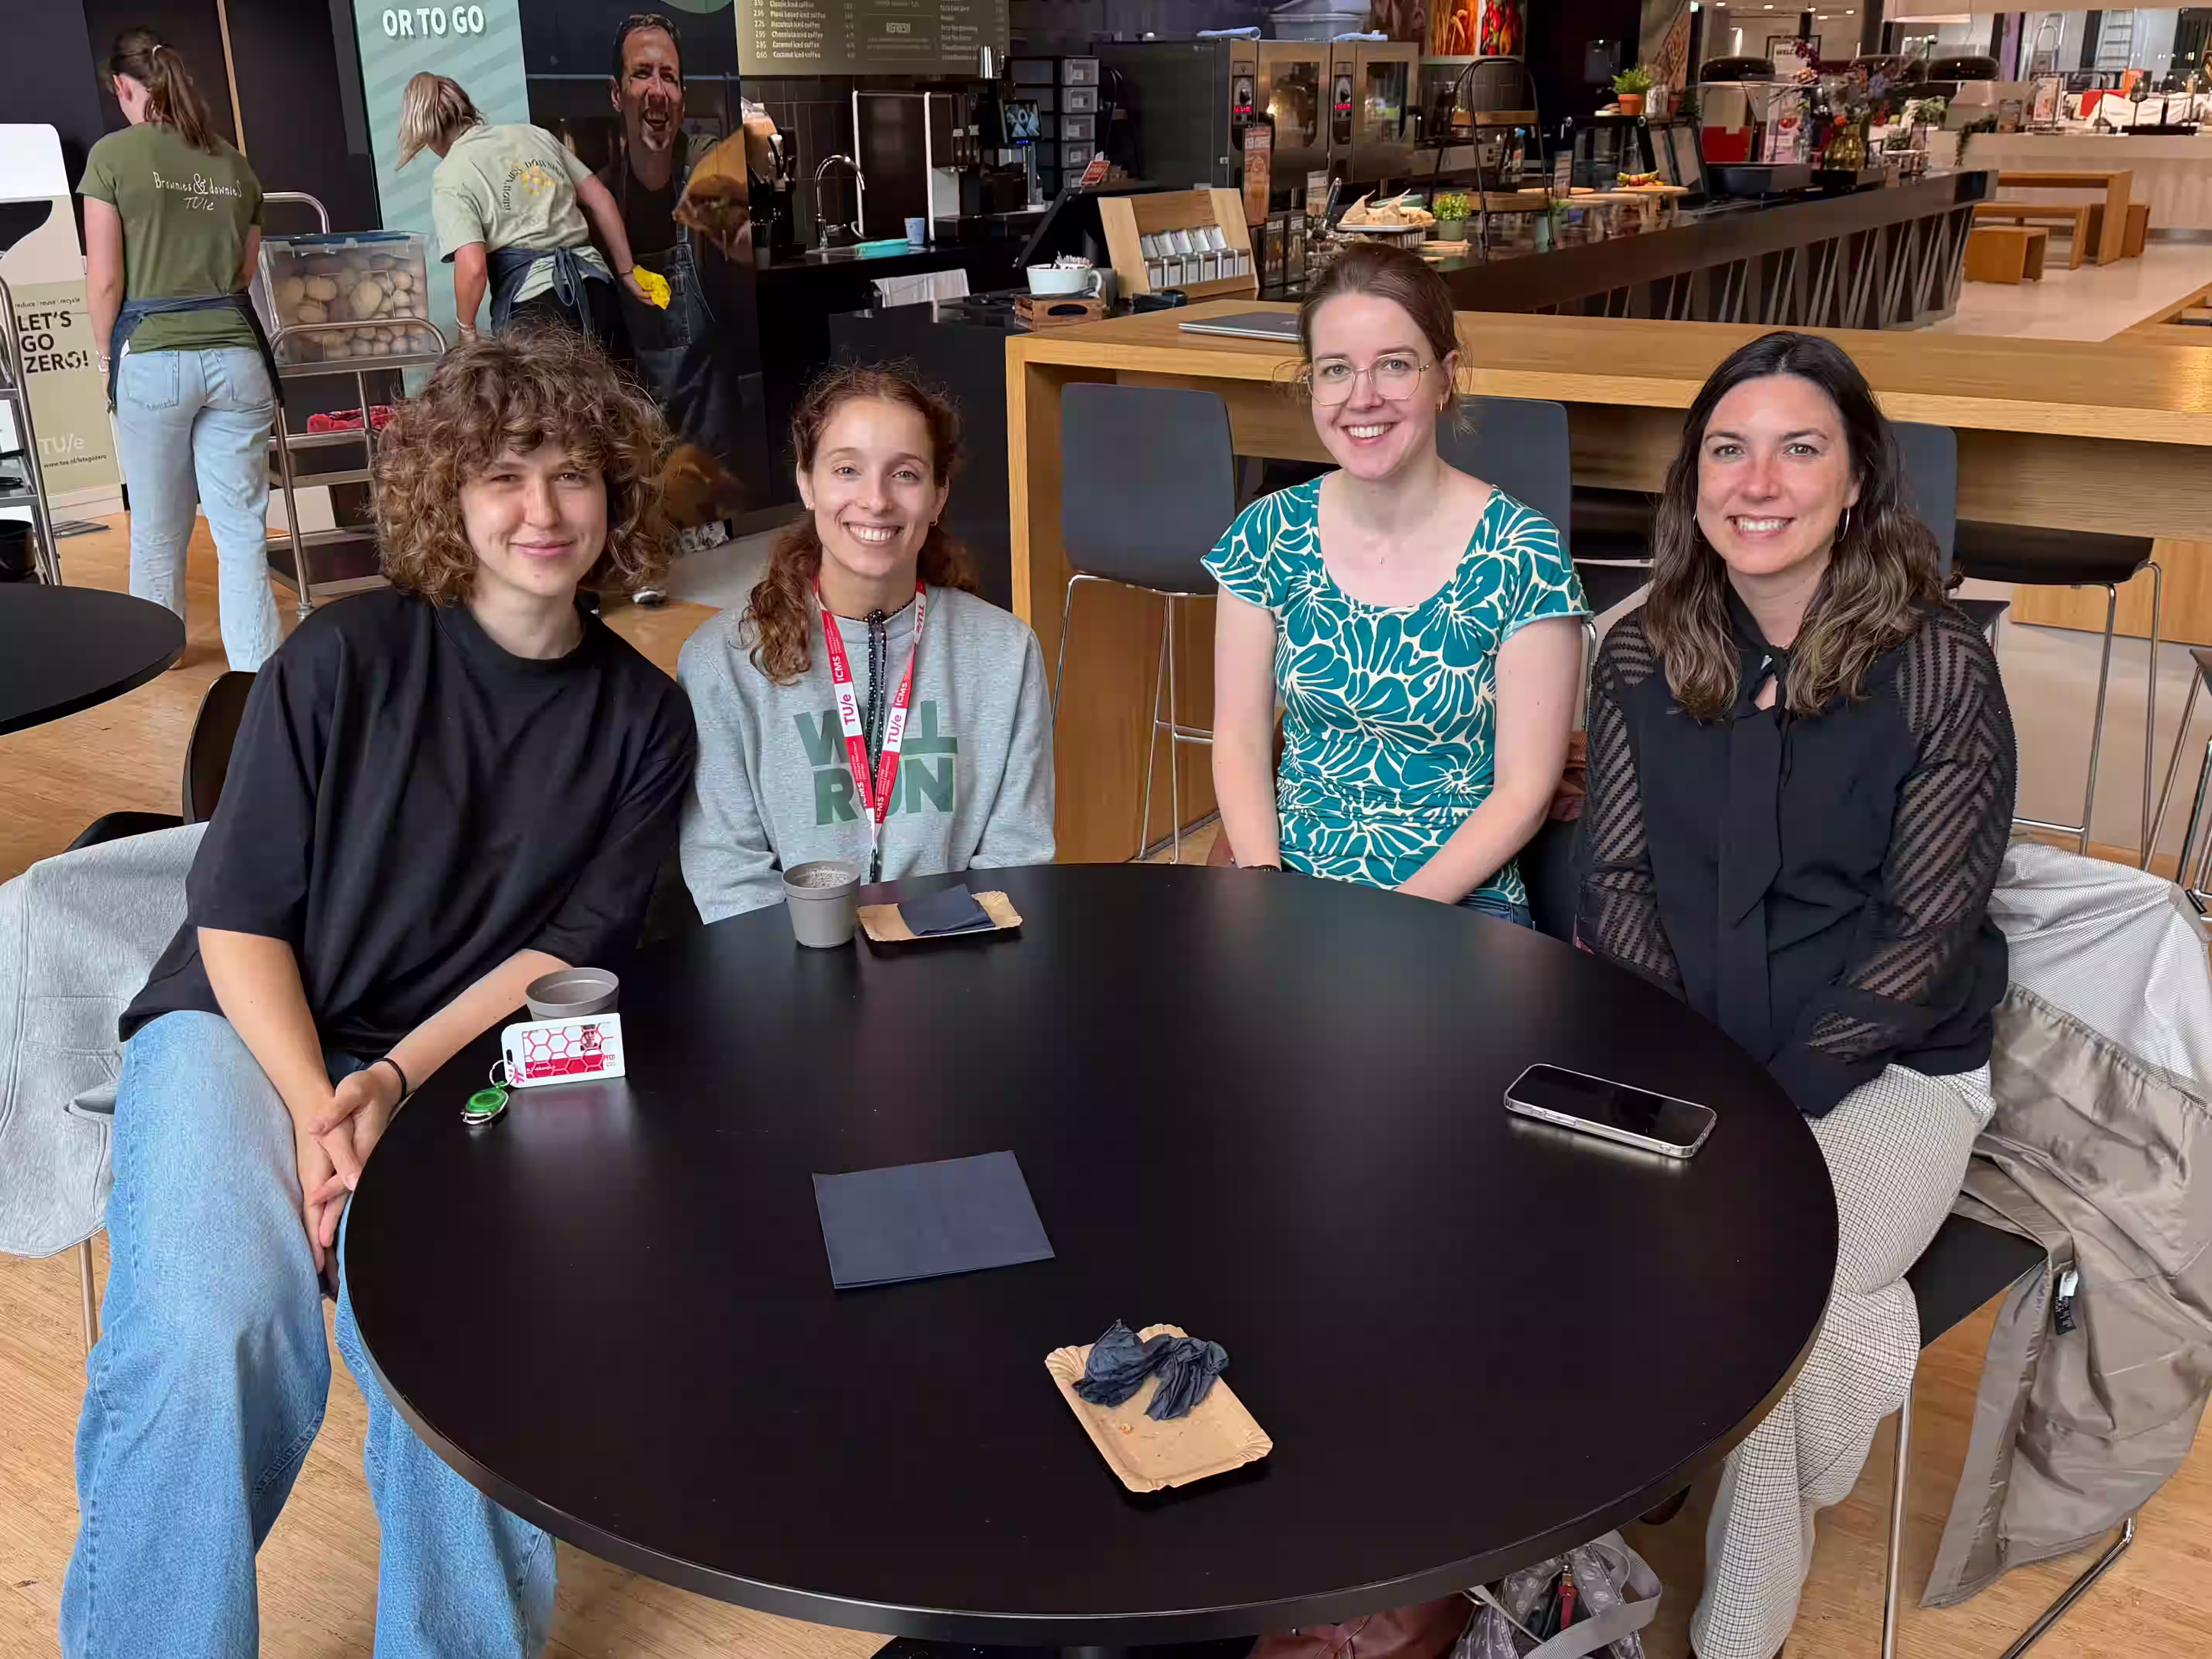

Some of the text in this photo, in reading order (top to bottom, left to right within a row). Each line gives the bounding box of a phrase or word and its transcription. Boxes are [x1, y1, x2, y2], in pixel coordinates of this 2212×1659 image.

[383, 5, 484, 36] OR TO GO
[153, 171, 192, 191] Brownies
[17, 311, 72, 332] LET'S
[21, 333, 55, 353] GO
[23, 350, 89, 374] ZERO!
[38, 433, 85, 455] TU/e
[833, 656, 845, 682] ICMS
[895, 682, 908, 707] ICMS
[840, 694, 855, 725] TU/e
[887, 714, 902, 745] TU/e
